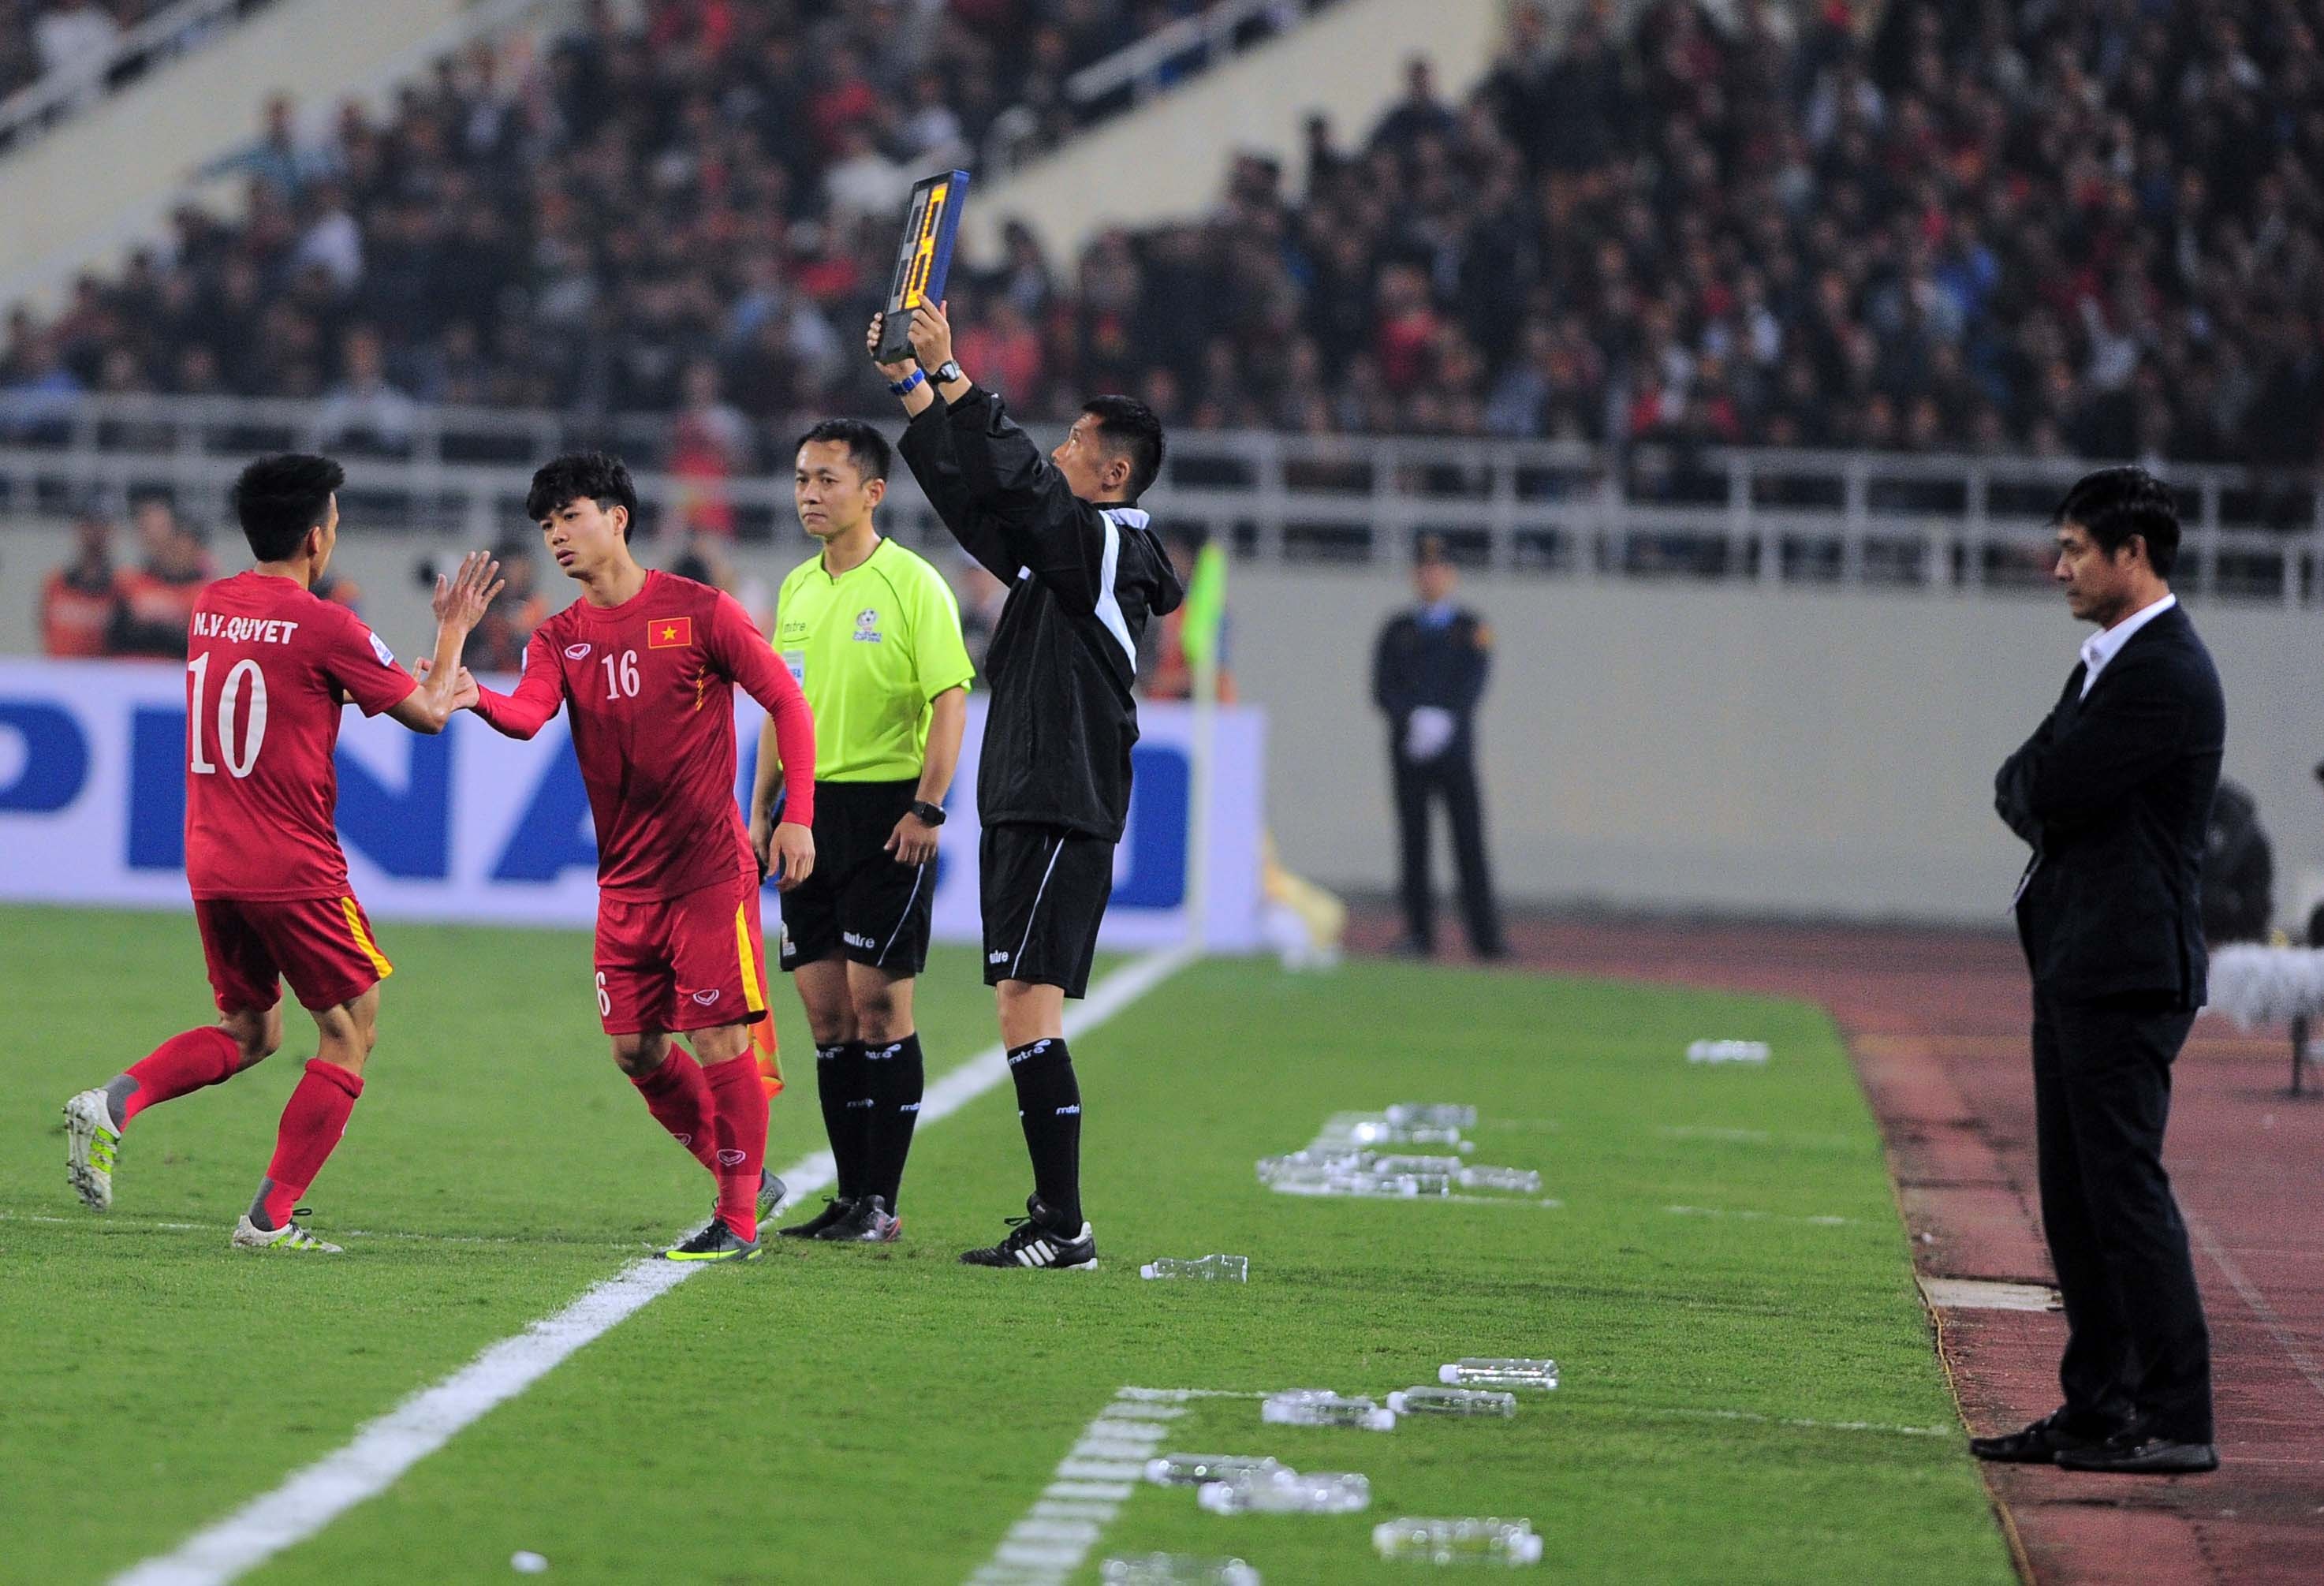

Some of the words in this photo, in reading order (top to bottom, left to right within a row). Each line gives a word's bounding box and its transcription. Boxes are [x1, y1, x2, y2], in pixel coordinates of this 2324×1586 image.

[194, 612, 298, 644] N.V.QUYET
[601, 649, 640, 700] 16
[188, 651, 267, 778] 10
[1009, 1046, 1046, 1066] mitre
